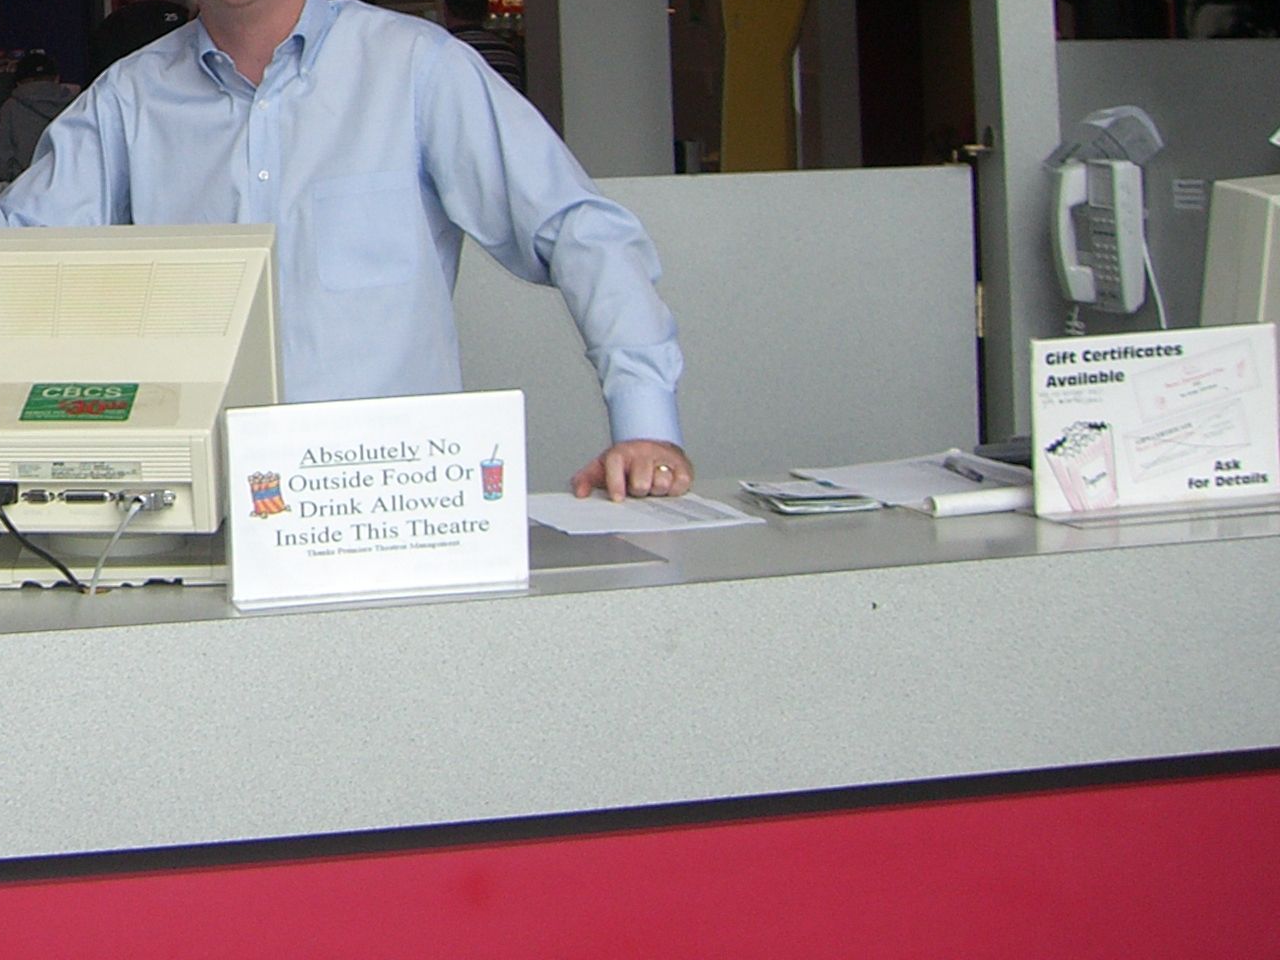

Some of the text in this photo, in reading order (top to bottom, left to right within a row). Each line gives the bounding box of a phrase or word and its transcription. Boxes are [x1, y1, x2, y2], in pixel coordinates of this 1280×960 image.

[1045, 343, 1184, 366] Gift Certificates
[1046, 369, 1125, 388] Available
[300, 439, 461, 466] Absolutely No
[288, 464, 475, 492] Outside Food Or
[1214, 459, 1241, 472] Ask
[1215, 471, 1269, 487] Details
[300, 491, 465, 519] Drink Allowed
[275, 517, 490, 548] Inside This Theatre
